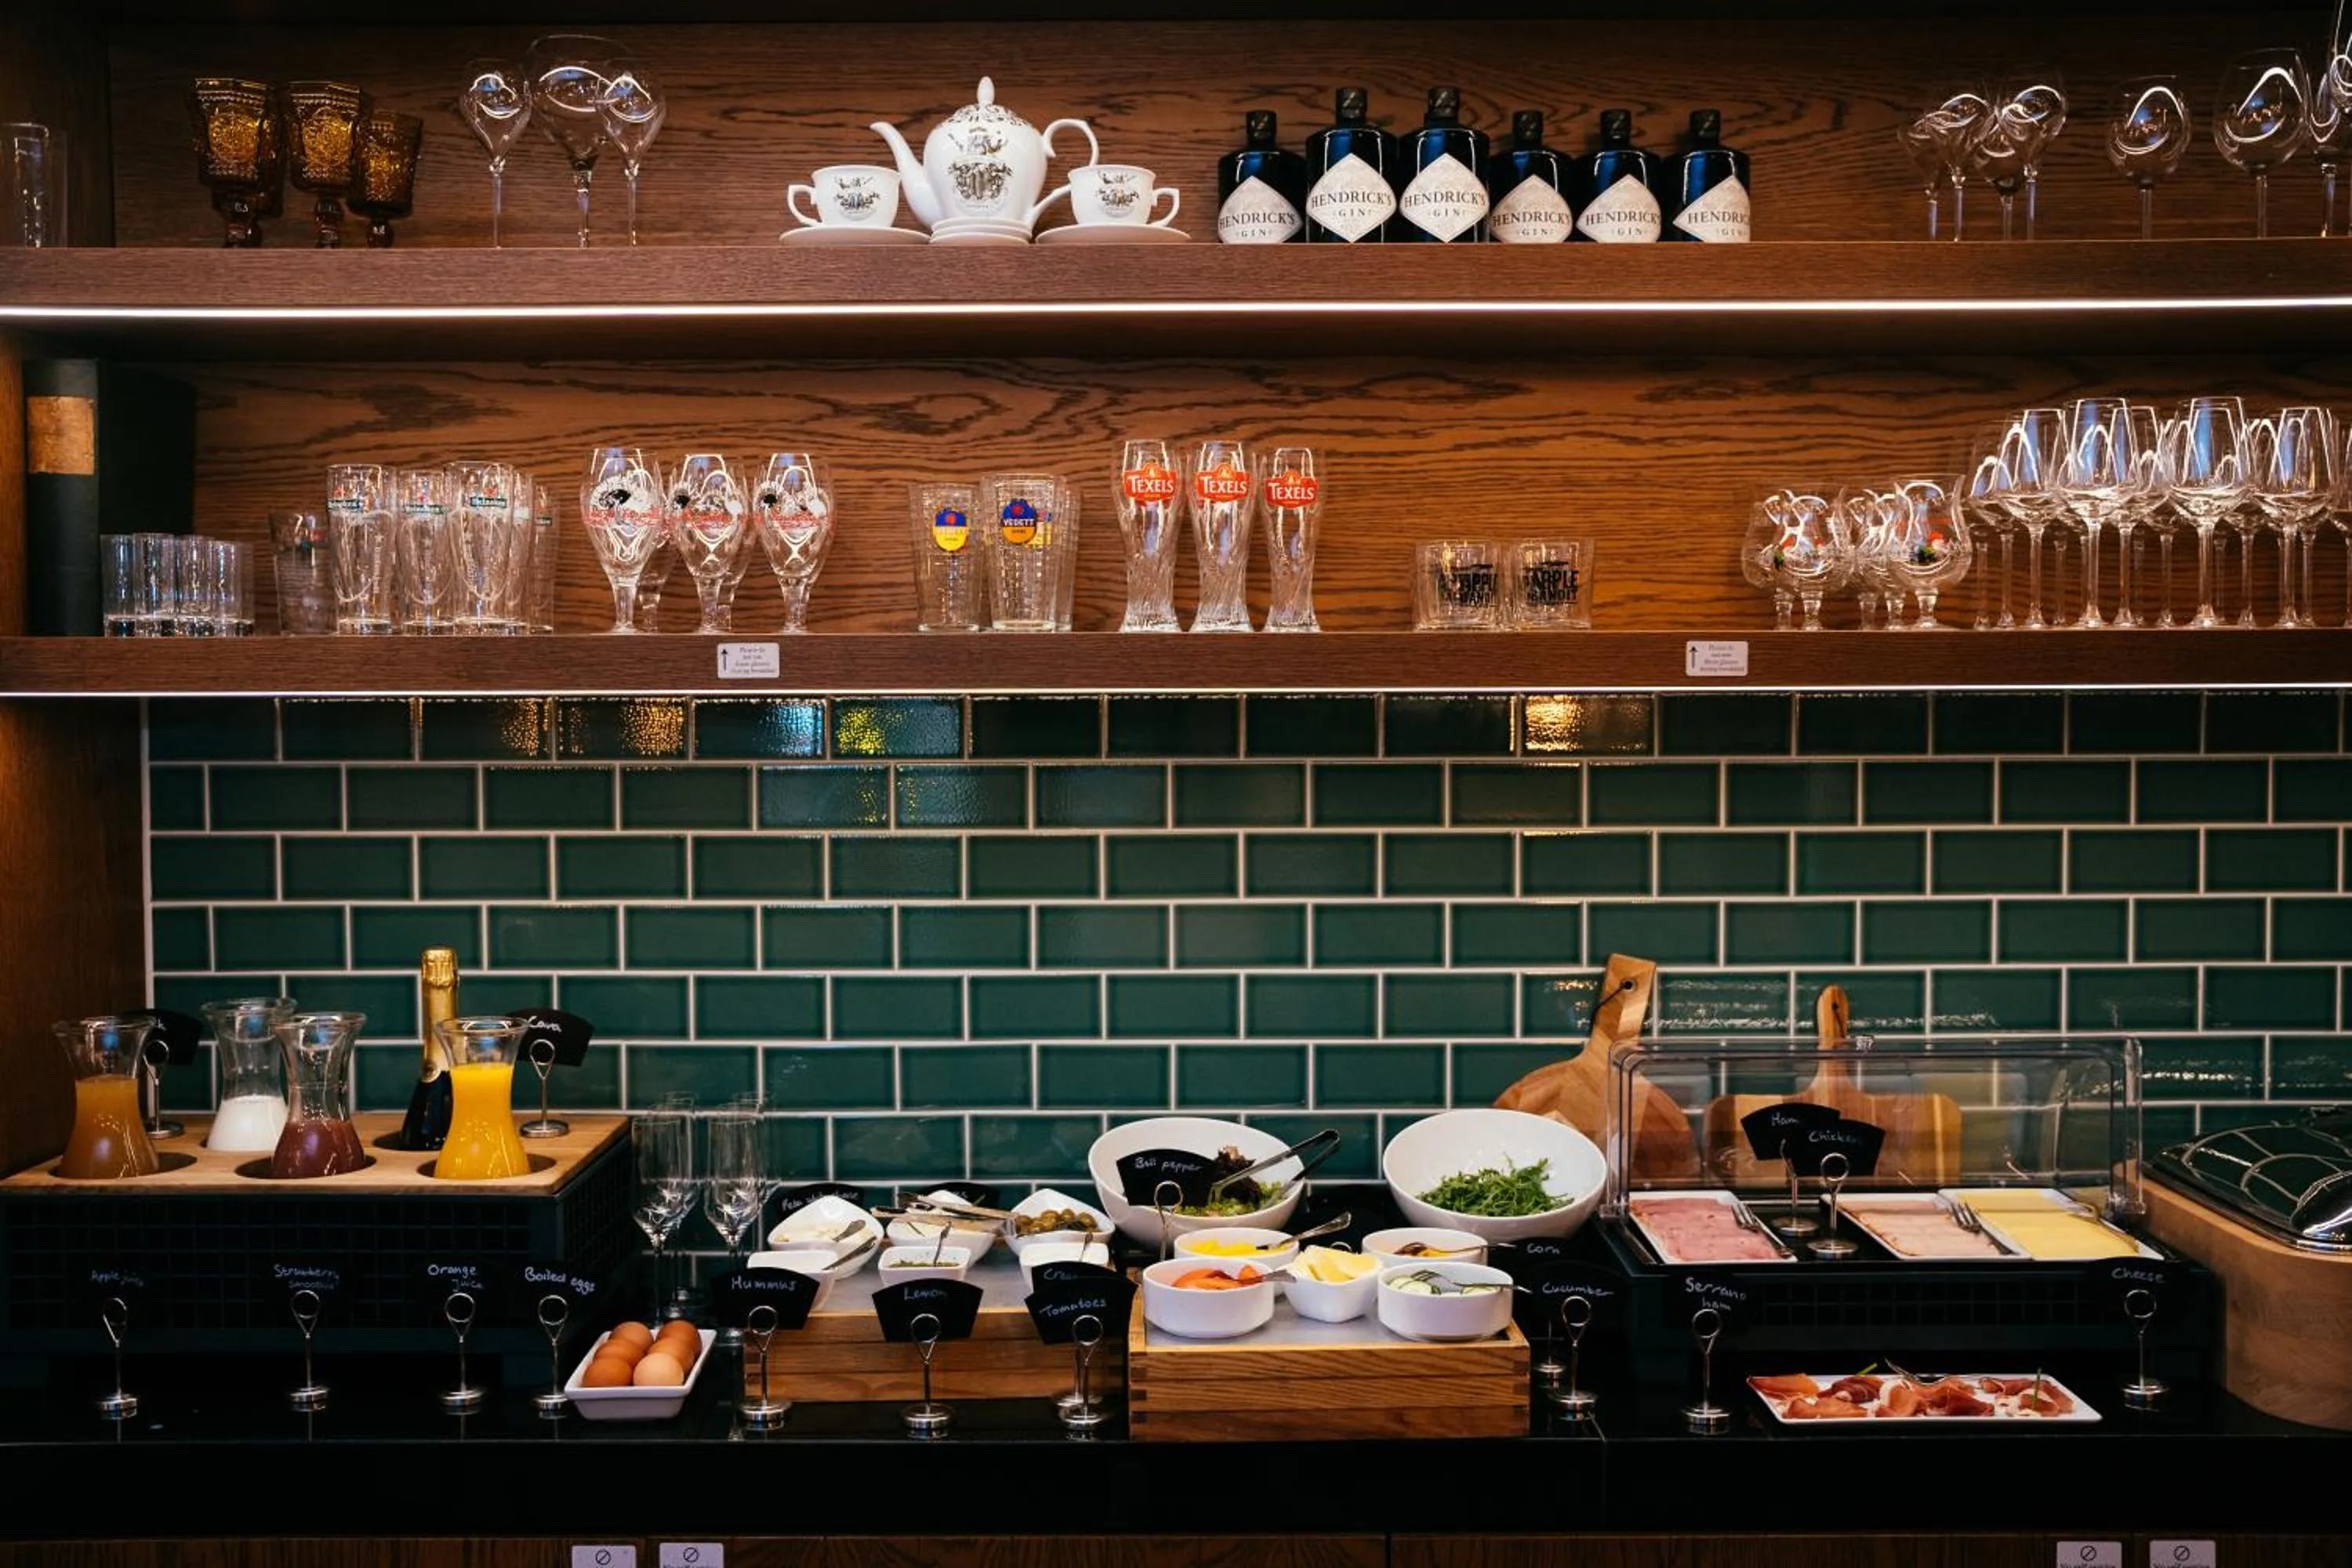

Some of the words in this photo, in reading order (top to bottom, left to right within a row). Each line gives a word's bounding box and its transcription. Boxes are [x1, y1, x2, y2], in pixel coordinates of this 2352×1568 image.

[1311, 190, 1392, 207] HENDRICK'S
[1403, 189, 1486, 207] HENDRICK'S
[1218, 212, 1295, 229] HENDRICK'S
[1338, 209, 1366, 217] GIN
[1432, 209, 1460, 217] GIN
[1241, 228, 1267, 238] GIN
[1127, 475, 1174, 493] TEXELS
[1200, 476, 1247, 494] TEXELS
[1268, 482, 1315, 500] TEXELS
[1527, 1243, 1560, 1254] Corn
[427, 1263, 477, 1279] Orange
[524, 1266, 566, 1283] Boiled
[2111, 1267, 2165, 1283] Cheese
[731, 1275, 797, 1291] Hummus
[1685, 1276, 1747, 1301] Serrano
[1039, 1298, 1107, 1317] Tomatoes
